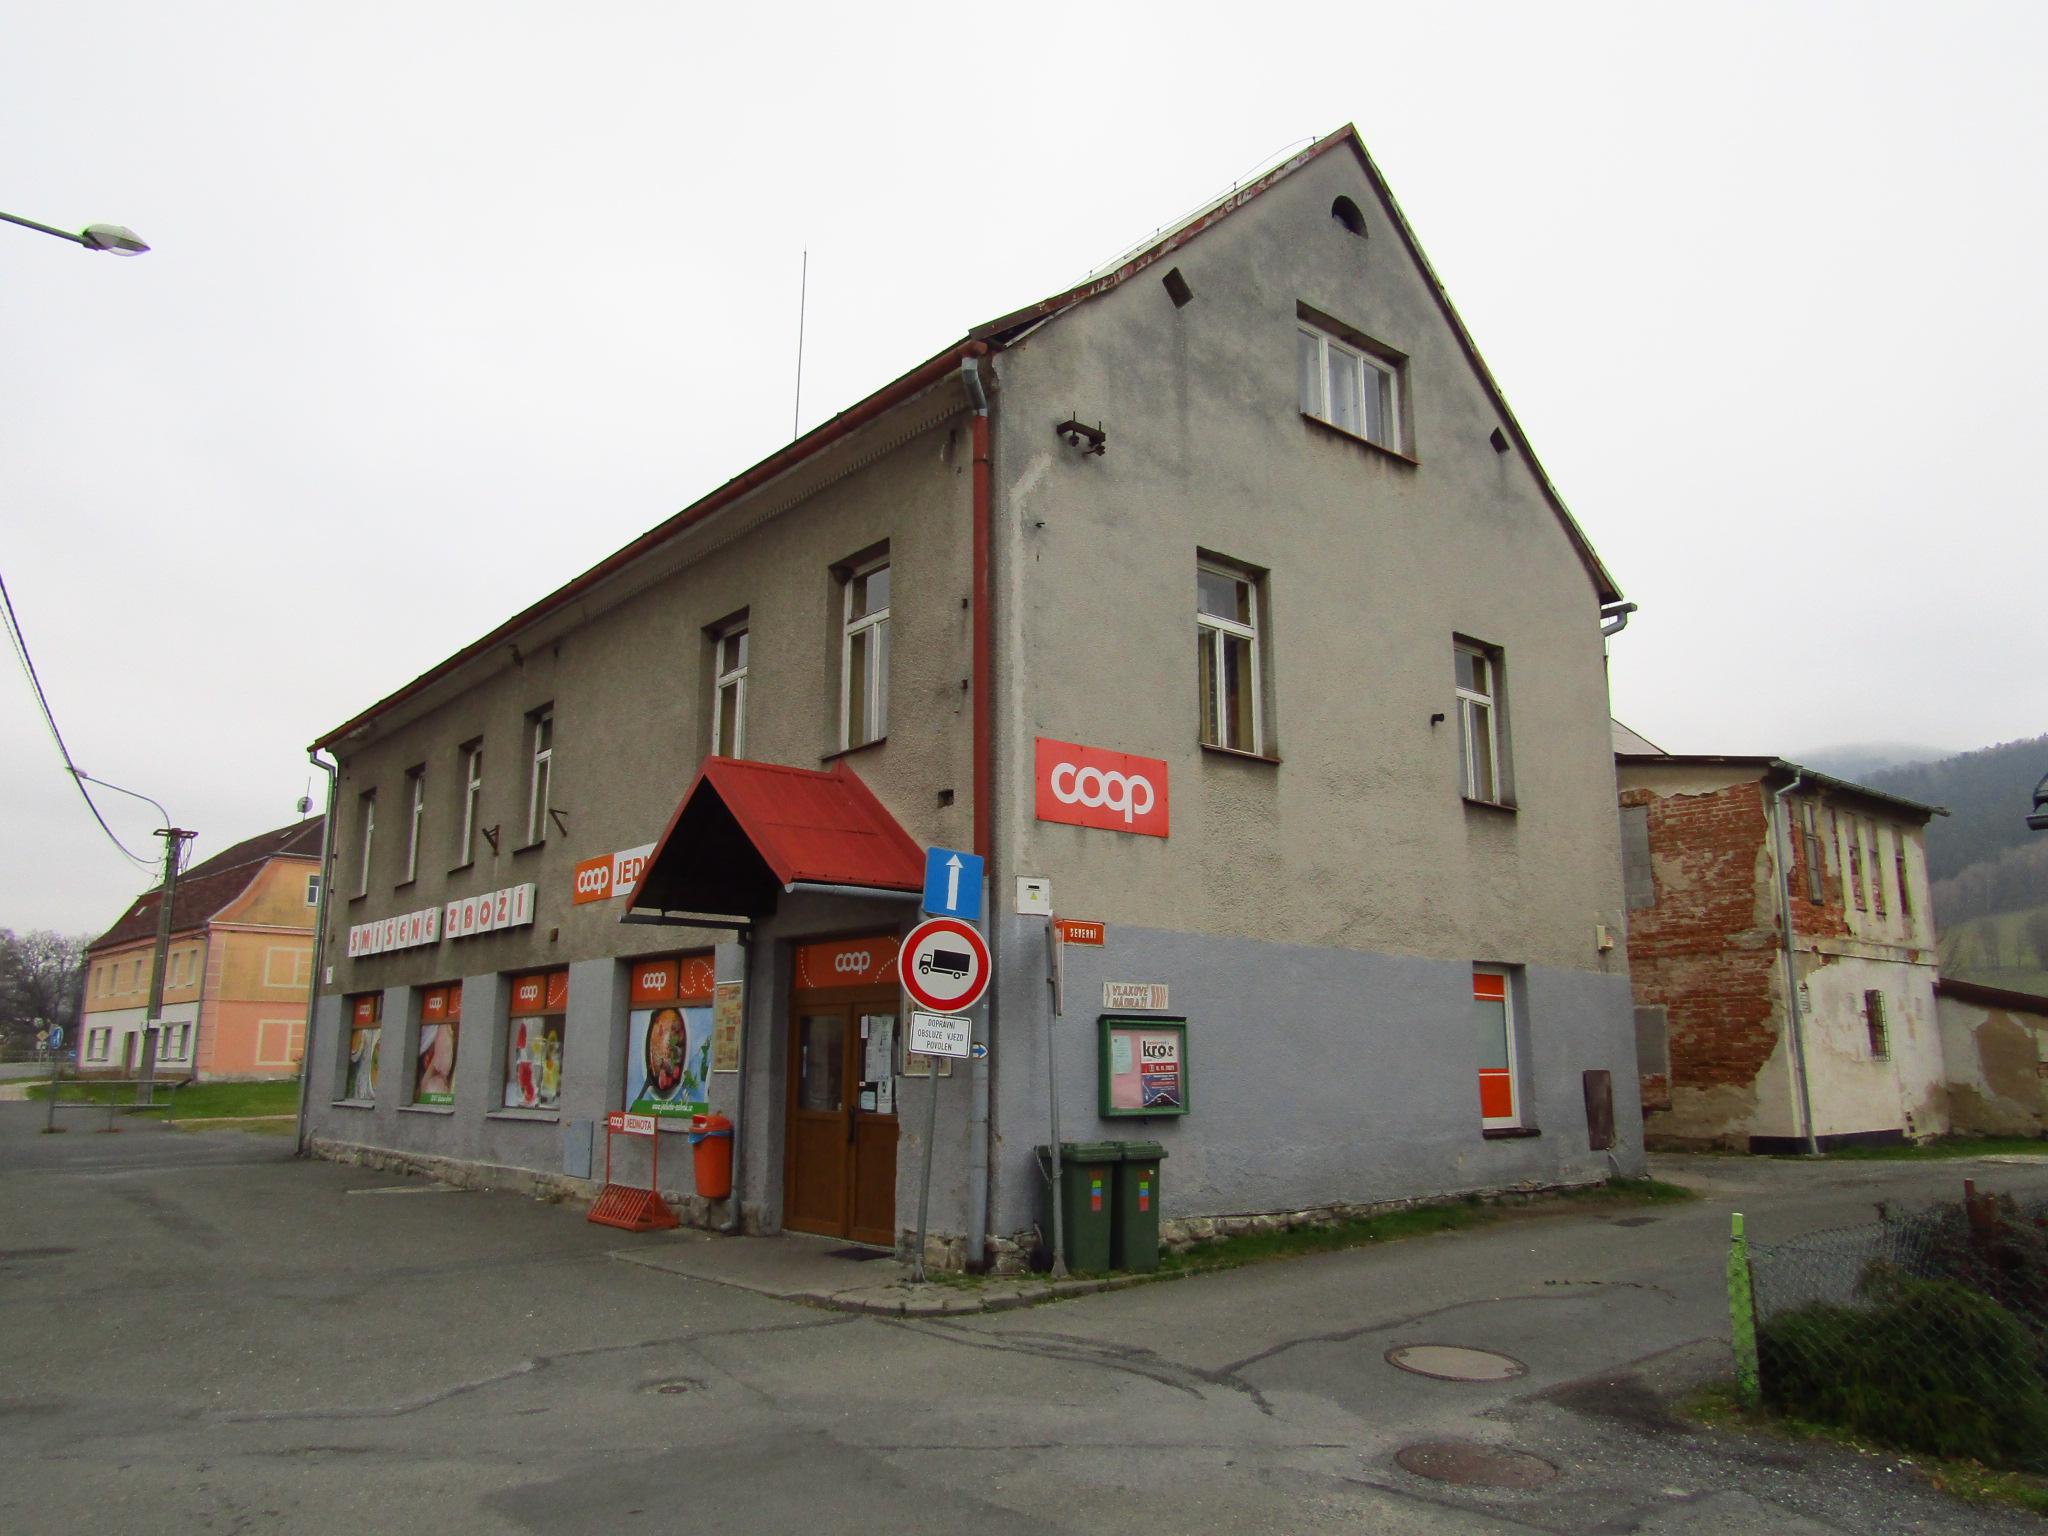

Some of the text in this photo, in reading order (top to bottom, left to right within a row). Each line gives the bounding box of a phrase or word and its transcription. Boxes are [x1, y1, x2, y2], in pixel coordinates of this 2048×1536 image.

[1051, 762, 1155, 824] coop
[578, 855, 650, 895] coop JED
[351, 886, 525, 952] SMÍŠENÉ ZBOŽÍ
[834, 951, 871, 975] coop
[643, 971, 667, 991] coop
[519, 985, 538, 1001] coop
[917, 1028, 964, 1042] OBSLUZE VJEZD
[926, 1040, 953, 1052] POVOLEN
[1142, 1040, 1175, 1058] kros
